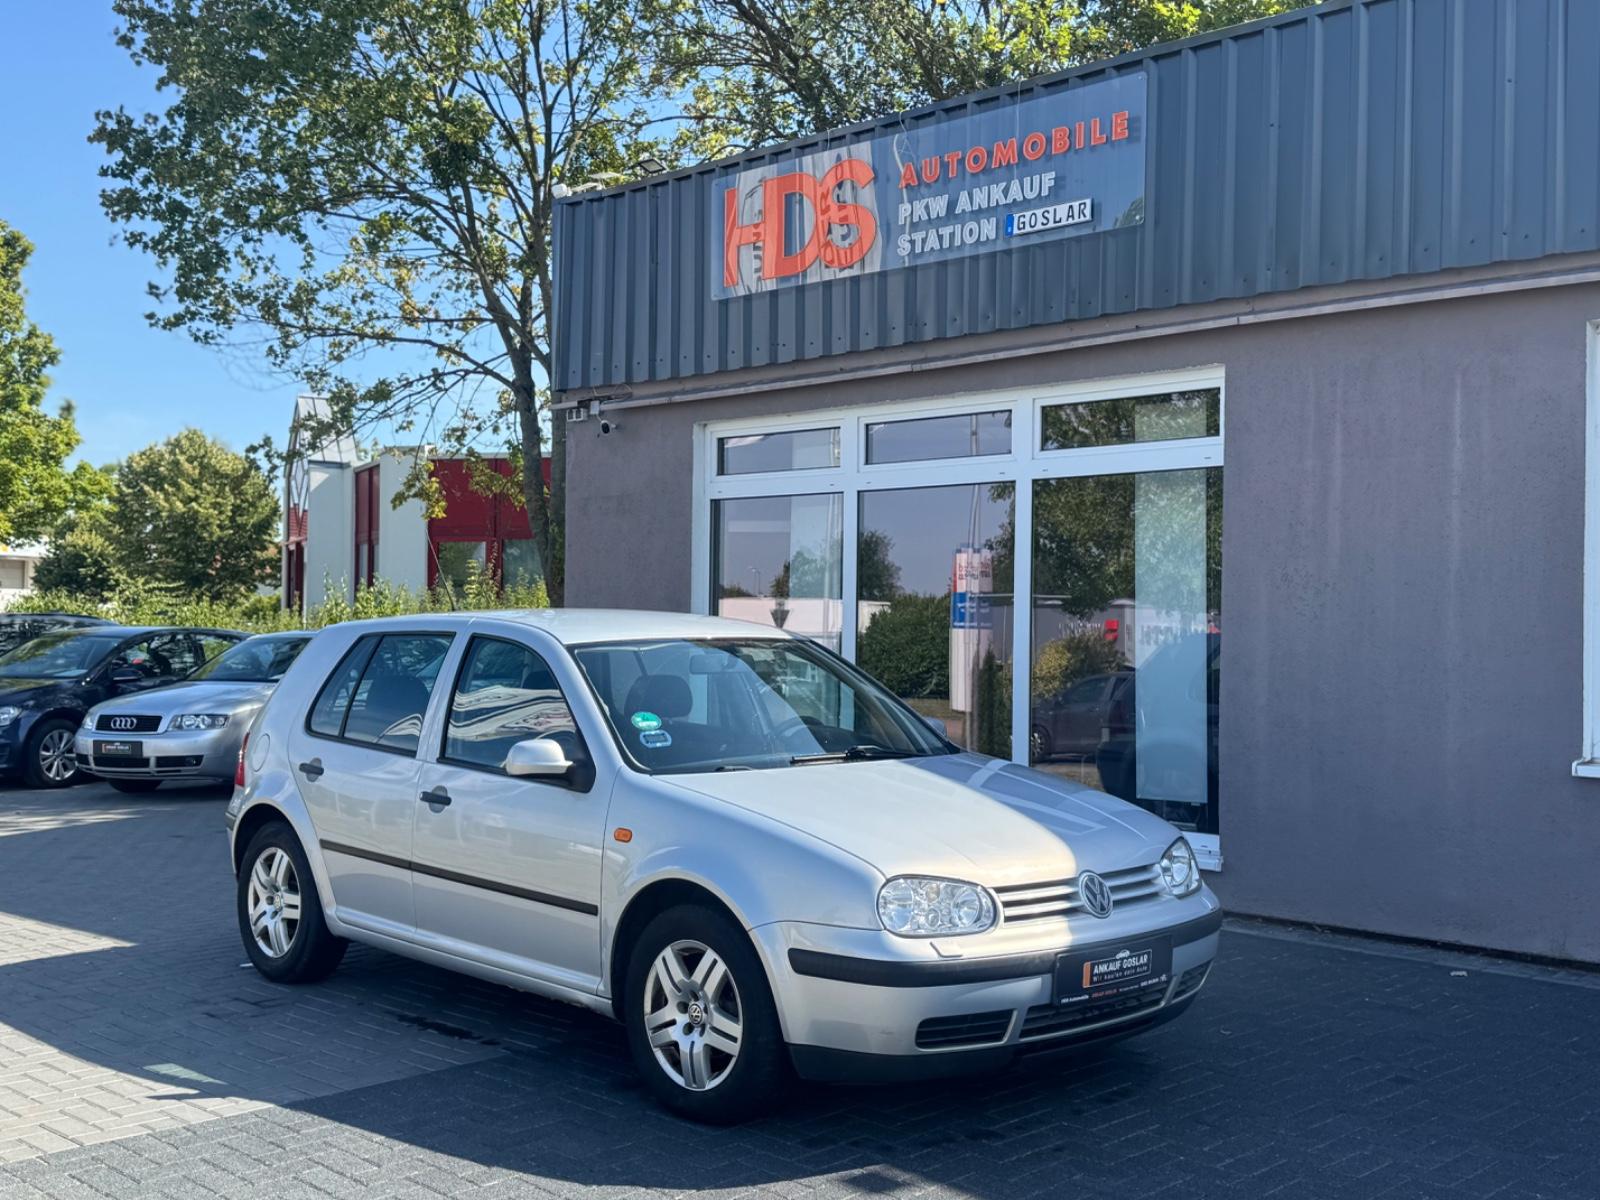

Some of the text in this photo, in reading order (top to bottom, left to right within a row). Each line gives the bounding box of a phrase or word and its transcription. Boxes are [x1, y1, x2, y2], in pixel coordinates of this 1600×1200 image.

[898, 110, 1129, 188] AUTOMOBILE
[724, 159, 877, 288] HDS
[898, 171, 1056, 225] PKW ANKAUF
[897, 202, 1087, 257] STATION GOSLAR
[1093, 960, 1121, 975] ANKAUF
[1122, 954, 1148, 969] GOSLAR
